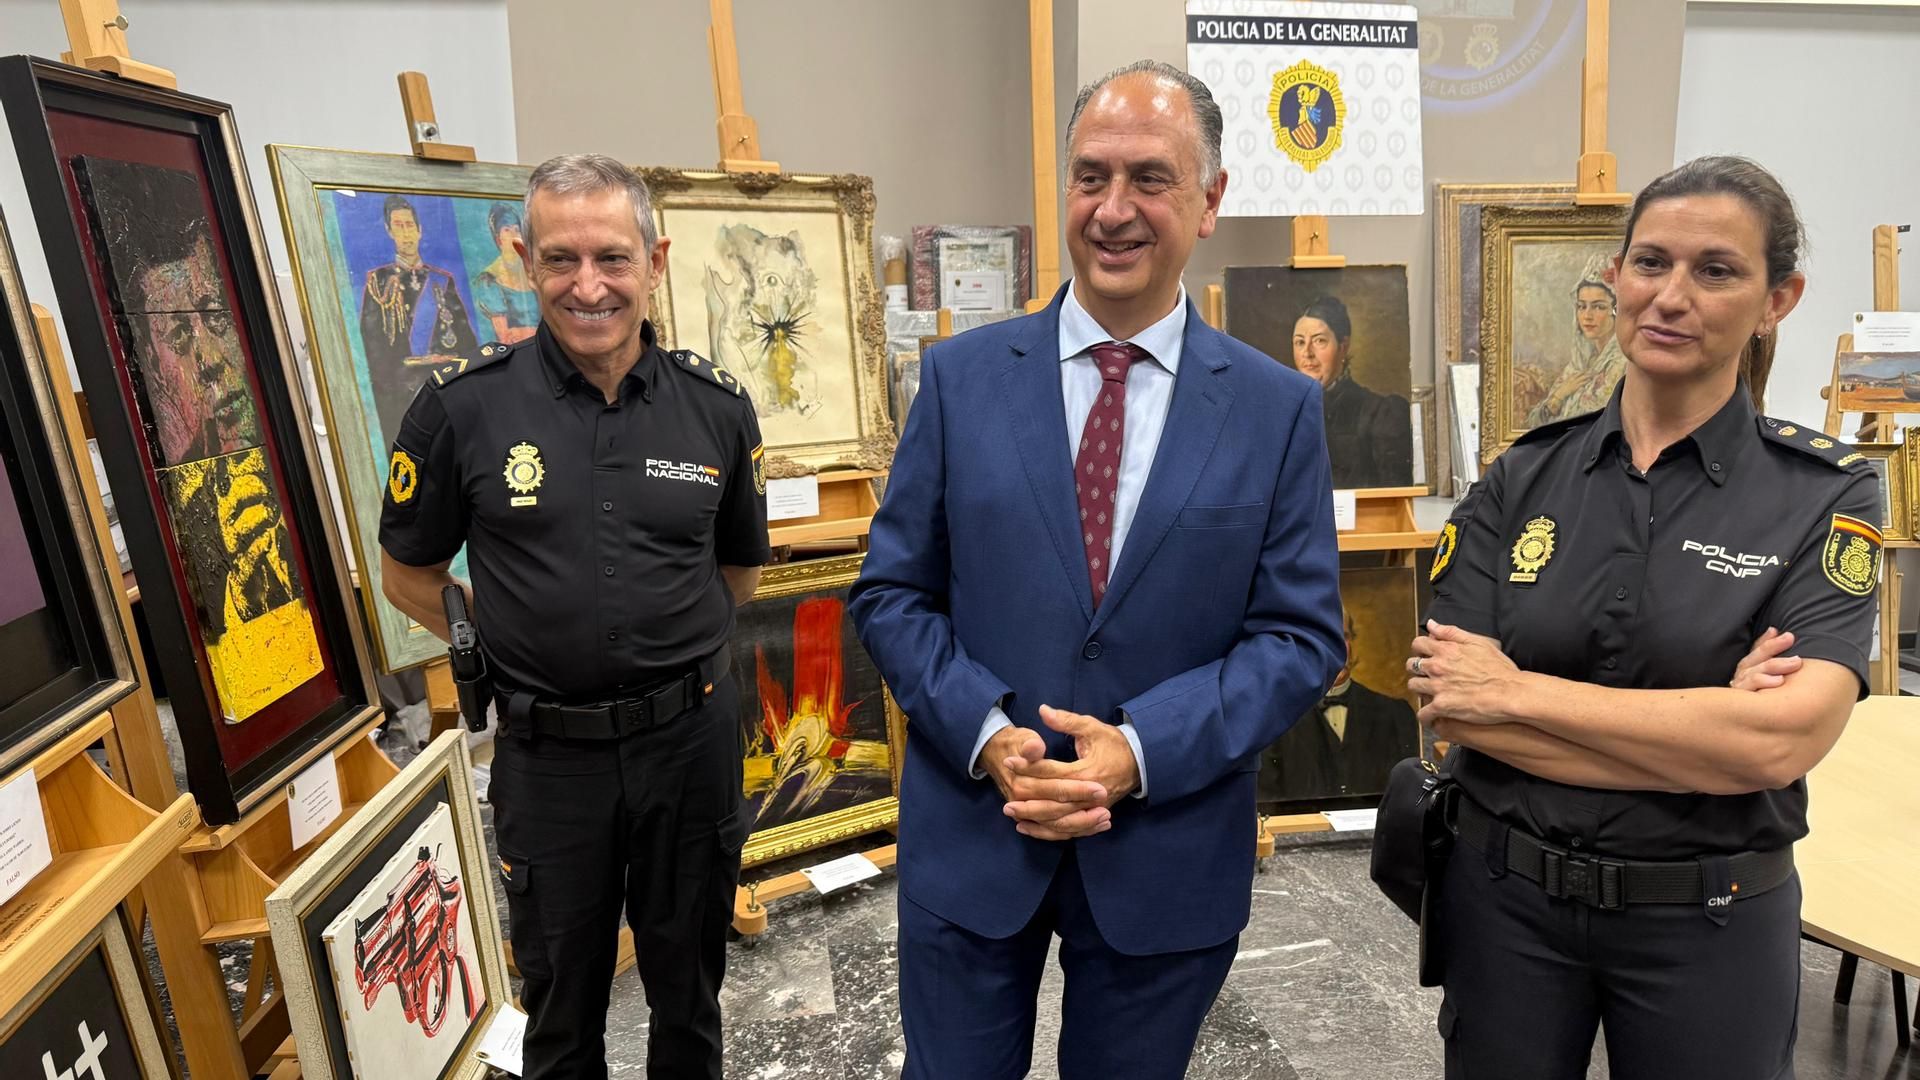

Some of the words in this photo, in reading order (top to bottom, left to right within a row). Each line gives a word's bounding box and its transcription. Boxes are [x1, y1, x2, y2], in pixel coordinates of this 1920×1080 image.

[1197, 20, 1260, 39] POLICIA
[1263, 22, 1284, 40] DE
[1288, 23, 1307, 41] LA
[1310, 23, 1408, 43] GENERALITAT
[1440, 82, 1457, 97] LA
[1460, 40, 1546, 96] GENERALITAT
[1280, 72, 1330, 87] POLICIA
[645, 458, 706, 474] POLICIA
[646, 467, 719, 487] NACIONAL
[1681, 539, 1780, 567] POLICIA
[1705, 559, 1762, 579] CNP
[1707, 895, 1733, 906] CNP
